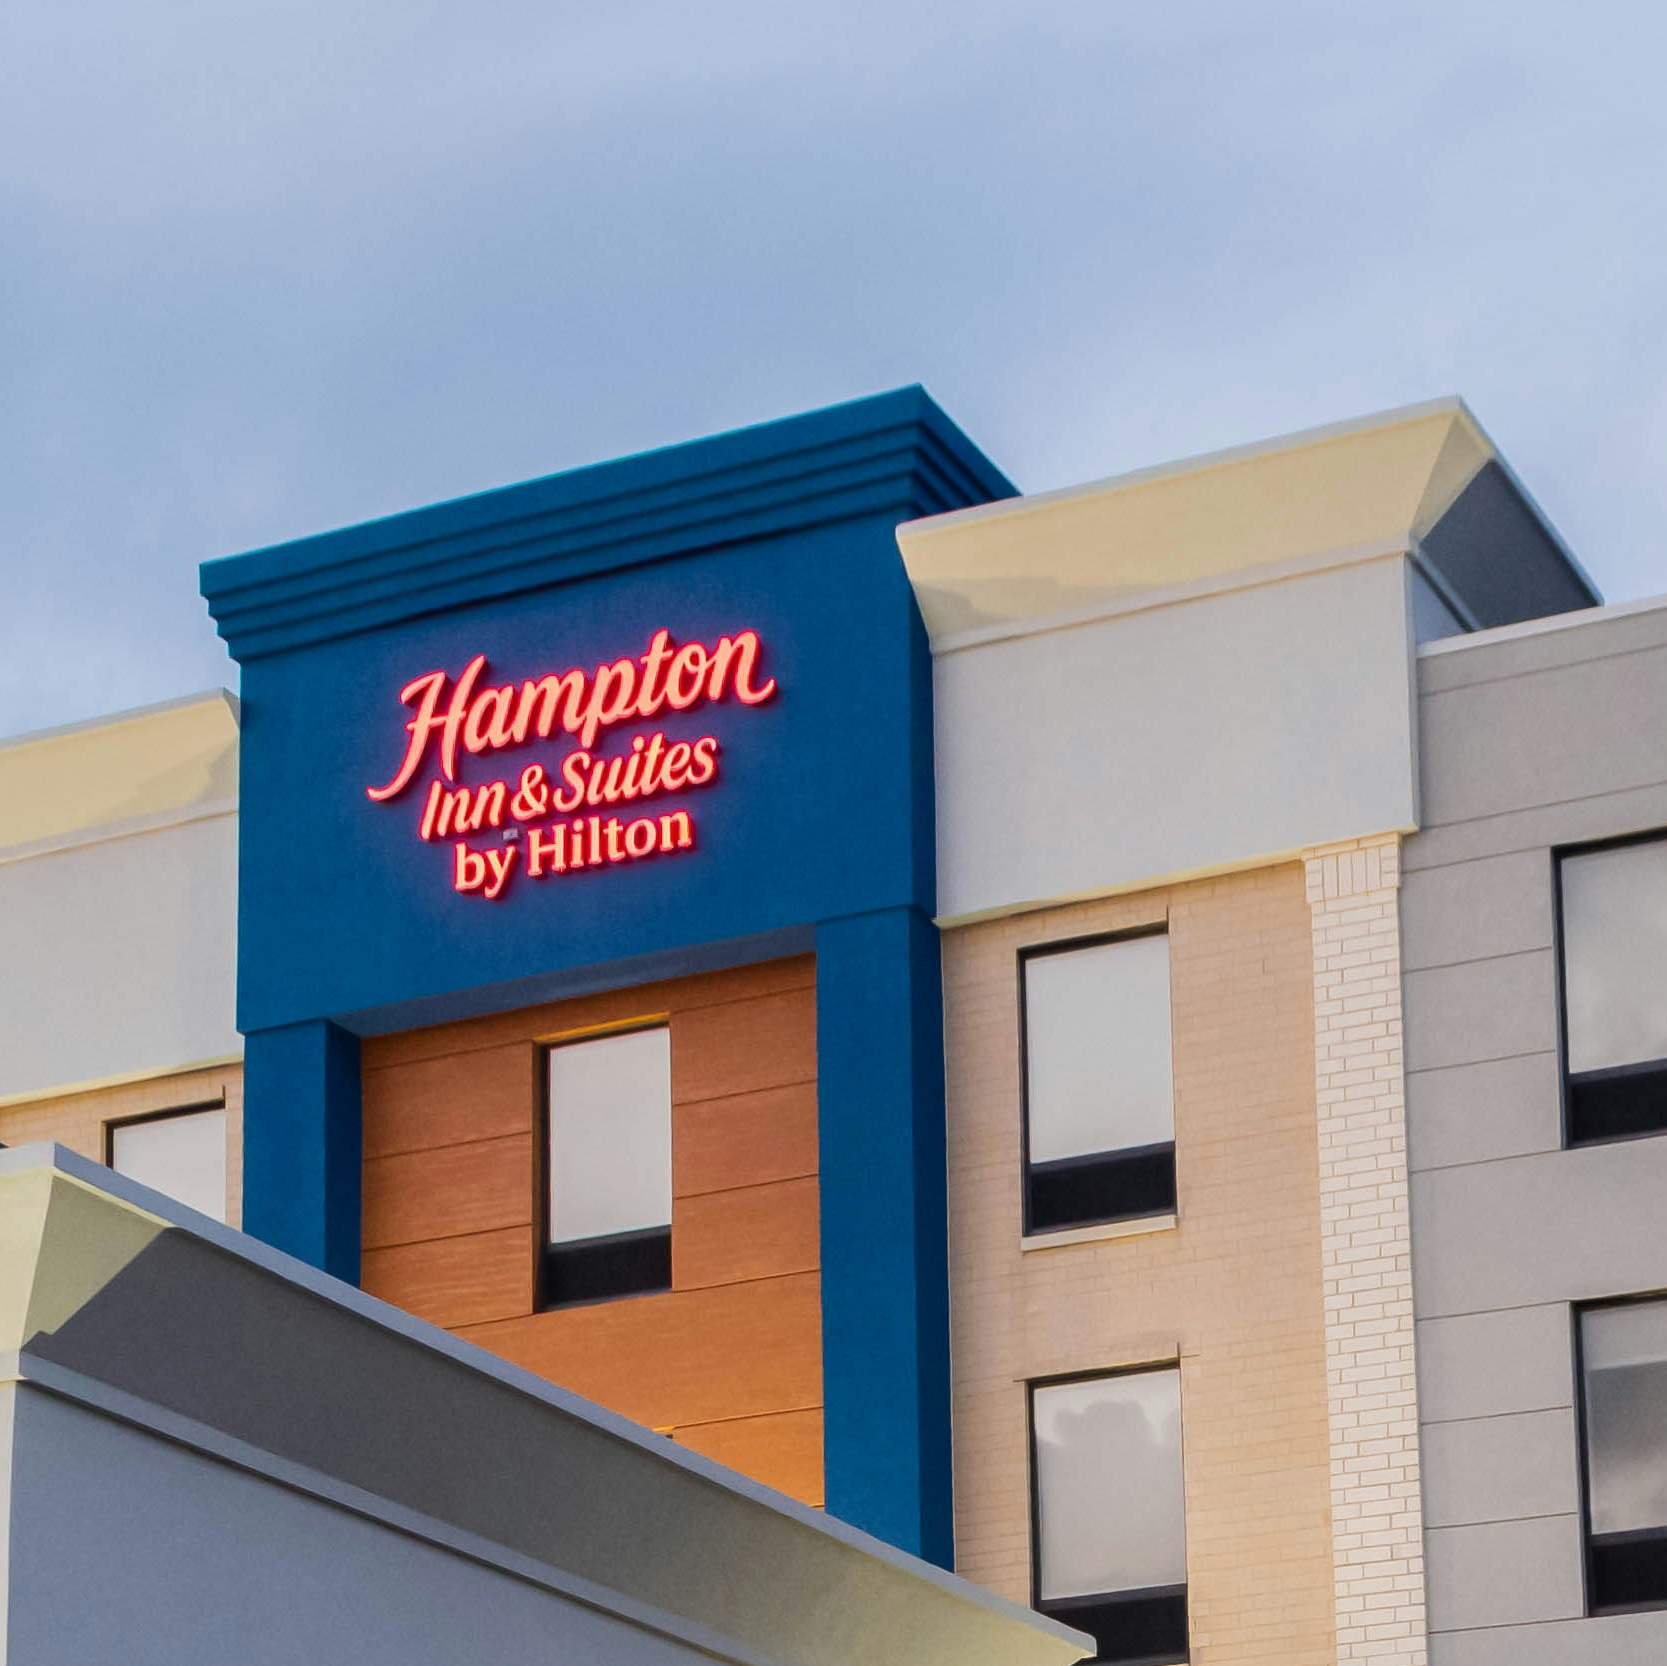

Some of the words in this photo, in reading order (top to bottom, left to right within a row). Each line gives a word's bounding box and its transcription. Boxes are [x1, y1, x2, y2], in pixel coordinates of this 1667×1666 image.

[367, 628, 776, 801] Hampton
[454, 841, 516, 898] by
[526, 808, 694, 878] Hilton
